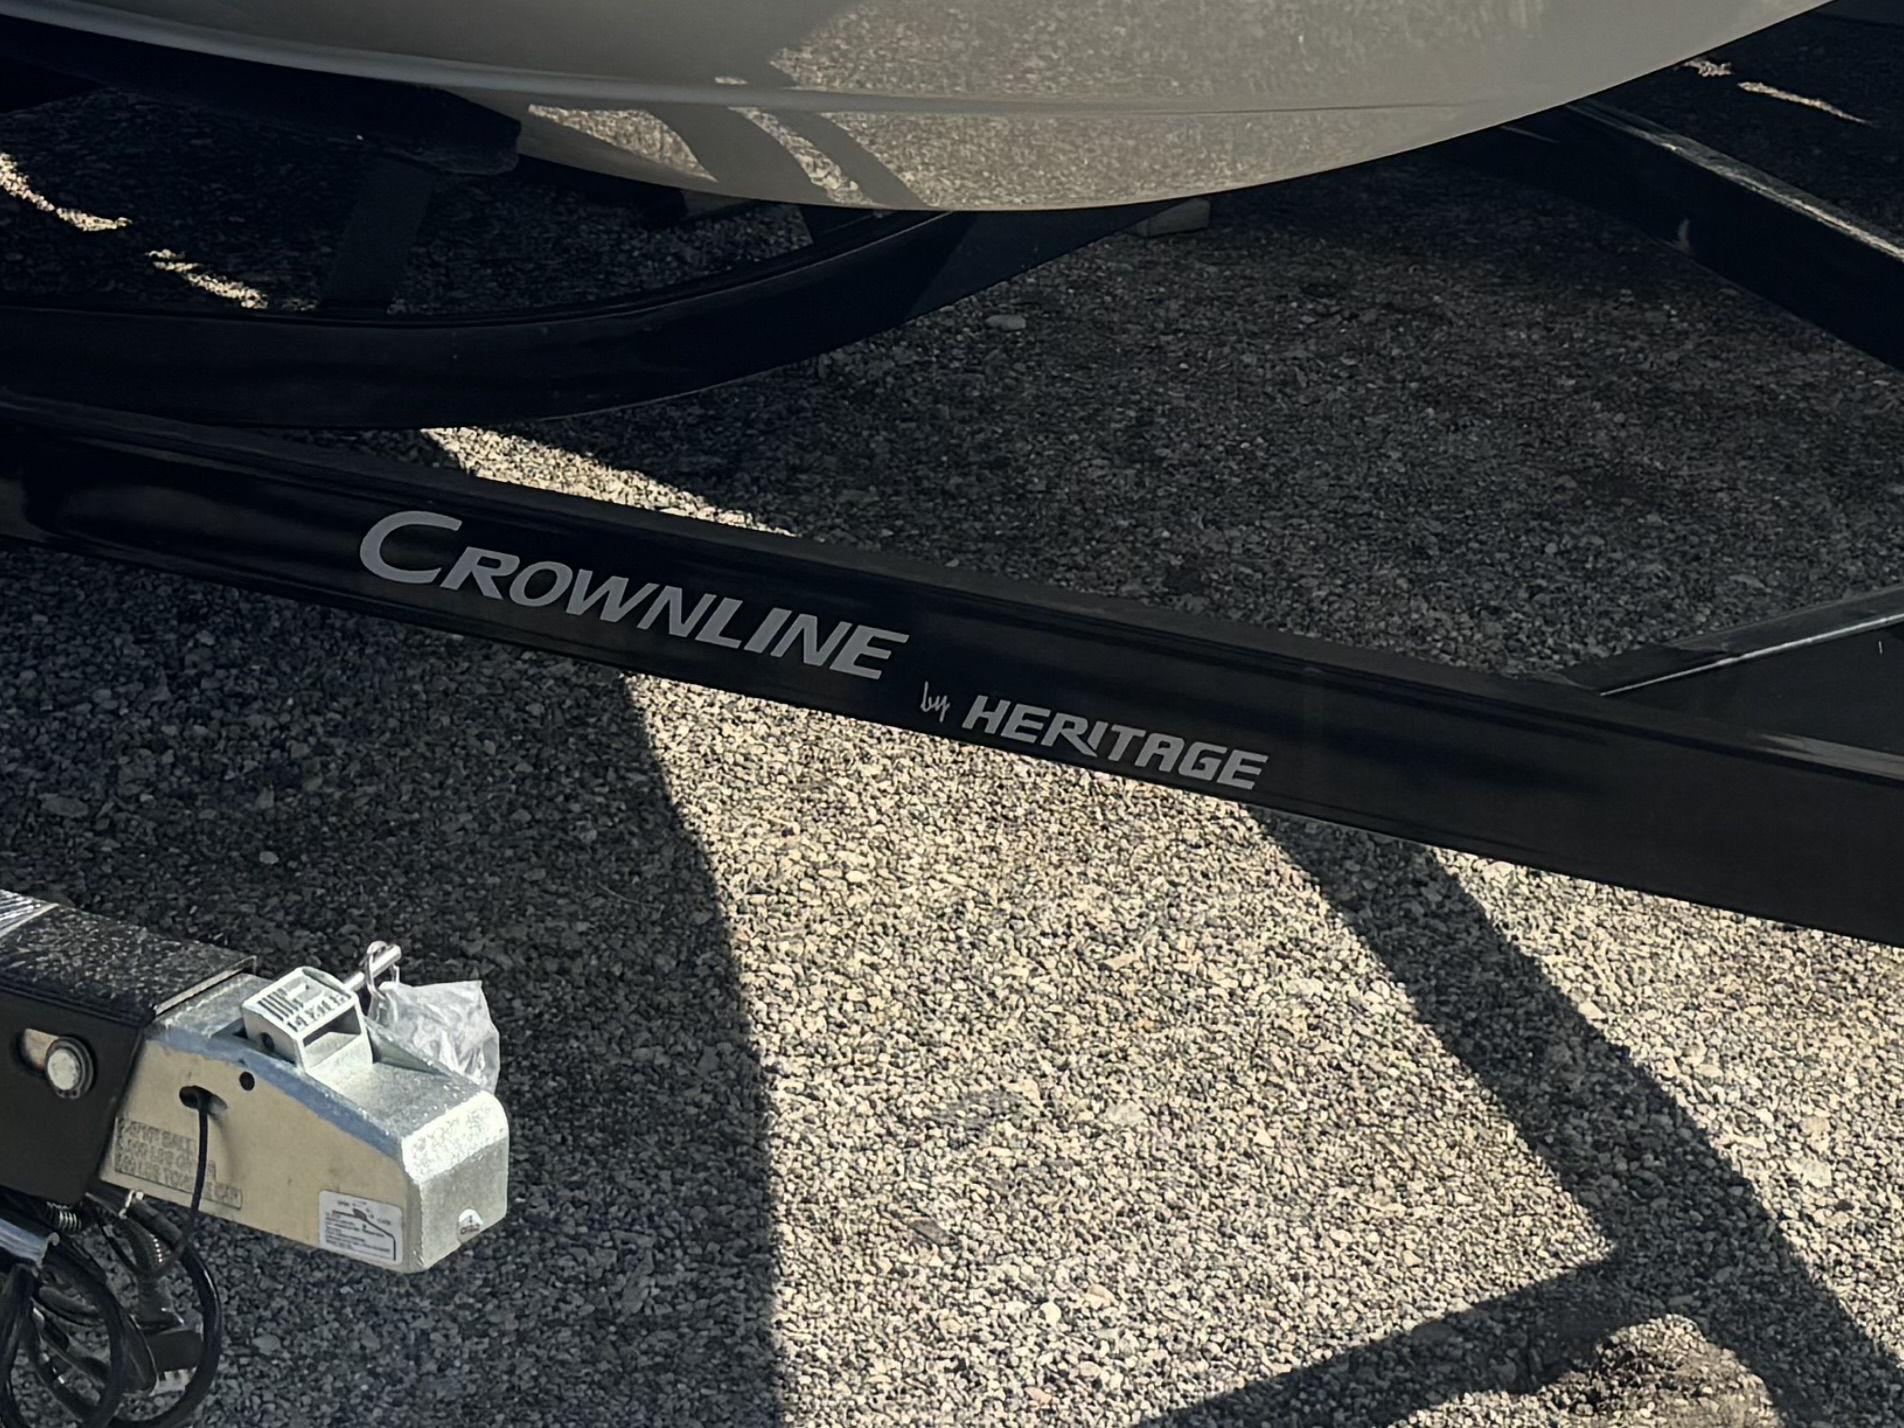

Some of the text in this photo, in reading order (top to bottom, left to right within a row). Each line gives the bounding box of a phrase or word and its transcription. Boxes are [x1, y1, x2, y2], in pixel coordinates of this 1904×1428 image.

[358, 509, 909, 680] CROWNLINE
[919, 681, 1270, 791] by HERITAGE
